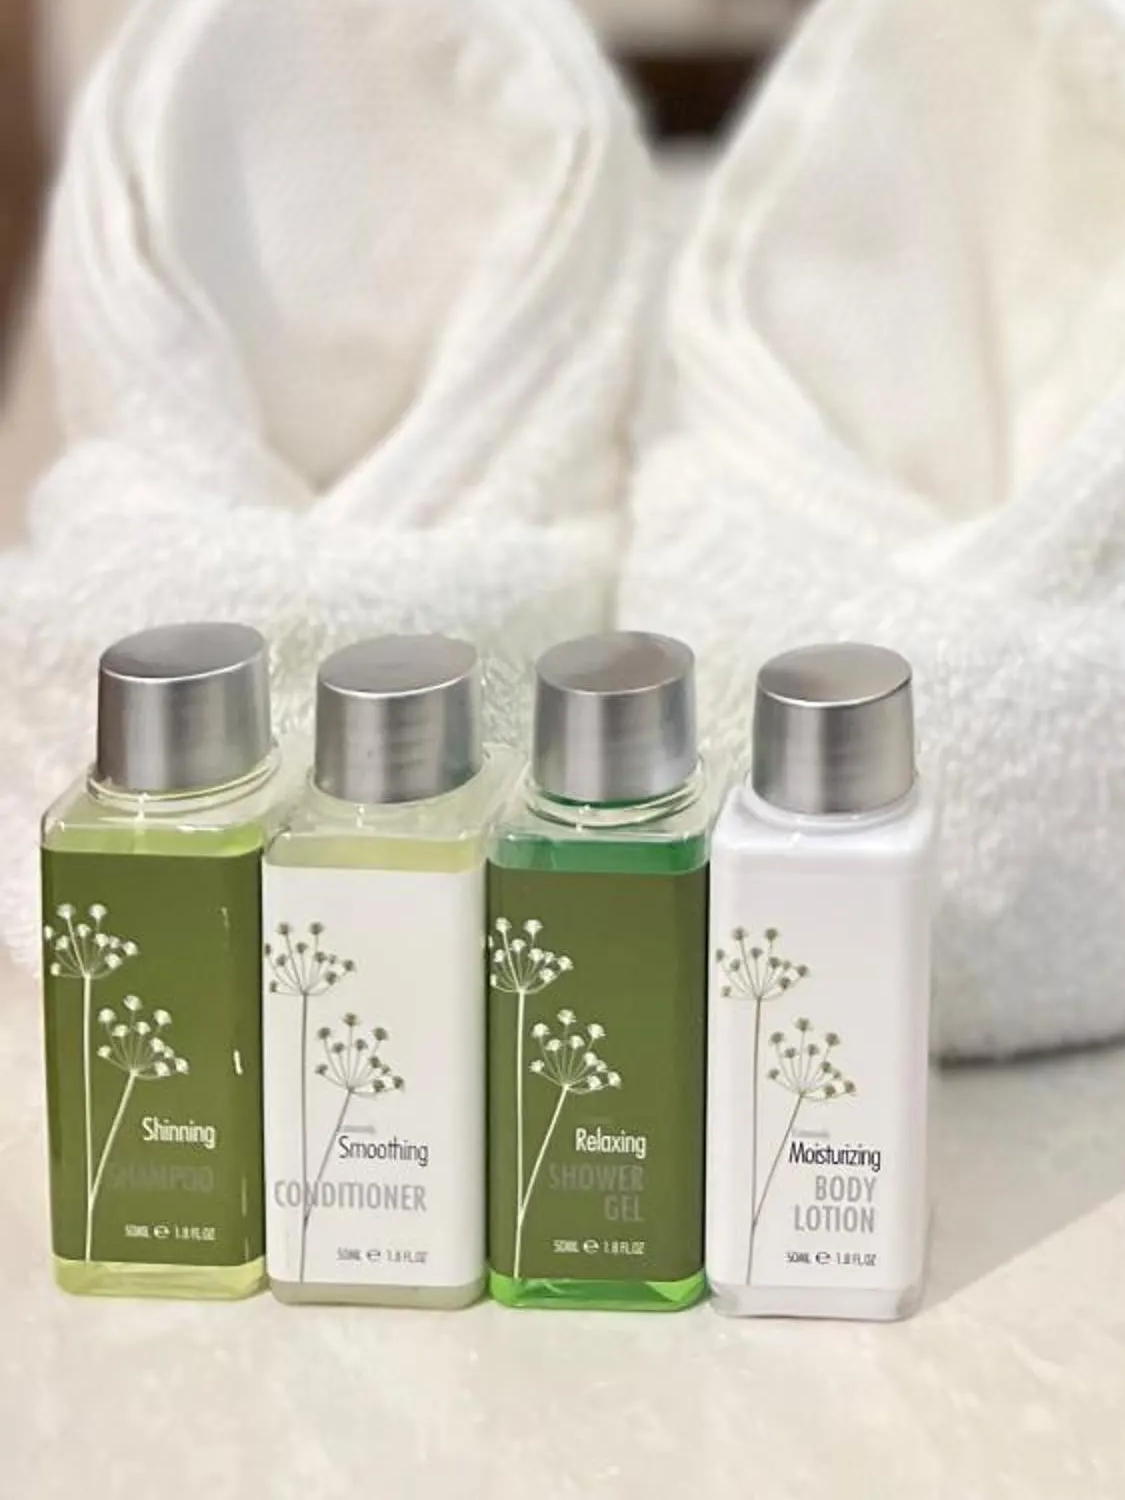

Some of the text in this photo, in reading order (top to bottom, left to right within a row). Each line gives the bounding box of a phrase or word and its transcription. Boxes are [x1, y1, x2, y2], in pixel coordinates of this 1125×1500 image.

[141, 1116, 216, 1150] Shinning
[575, 1126, 647, 1160] Relaxing
[338, 1135, 429, 1167] Smoothing
[789, 1140, 881, 1173] Moisturizing
[549, 1161, 645, 1193] SHOWER
[815, 1174, 877, 1204] BODY
[273, 1178, 428, 1213] CONDITIONER
[603, 1194, 645, 1223] GEL
[793, 1203, 876, 1235] LOTION
